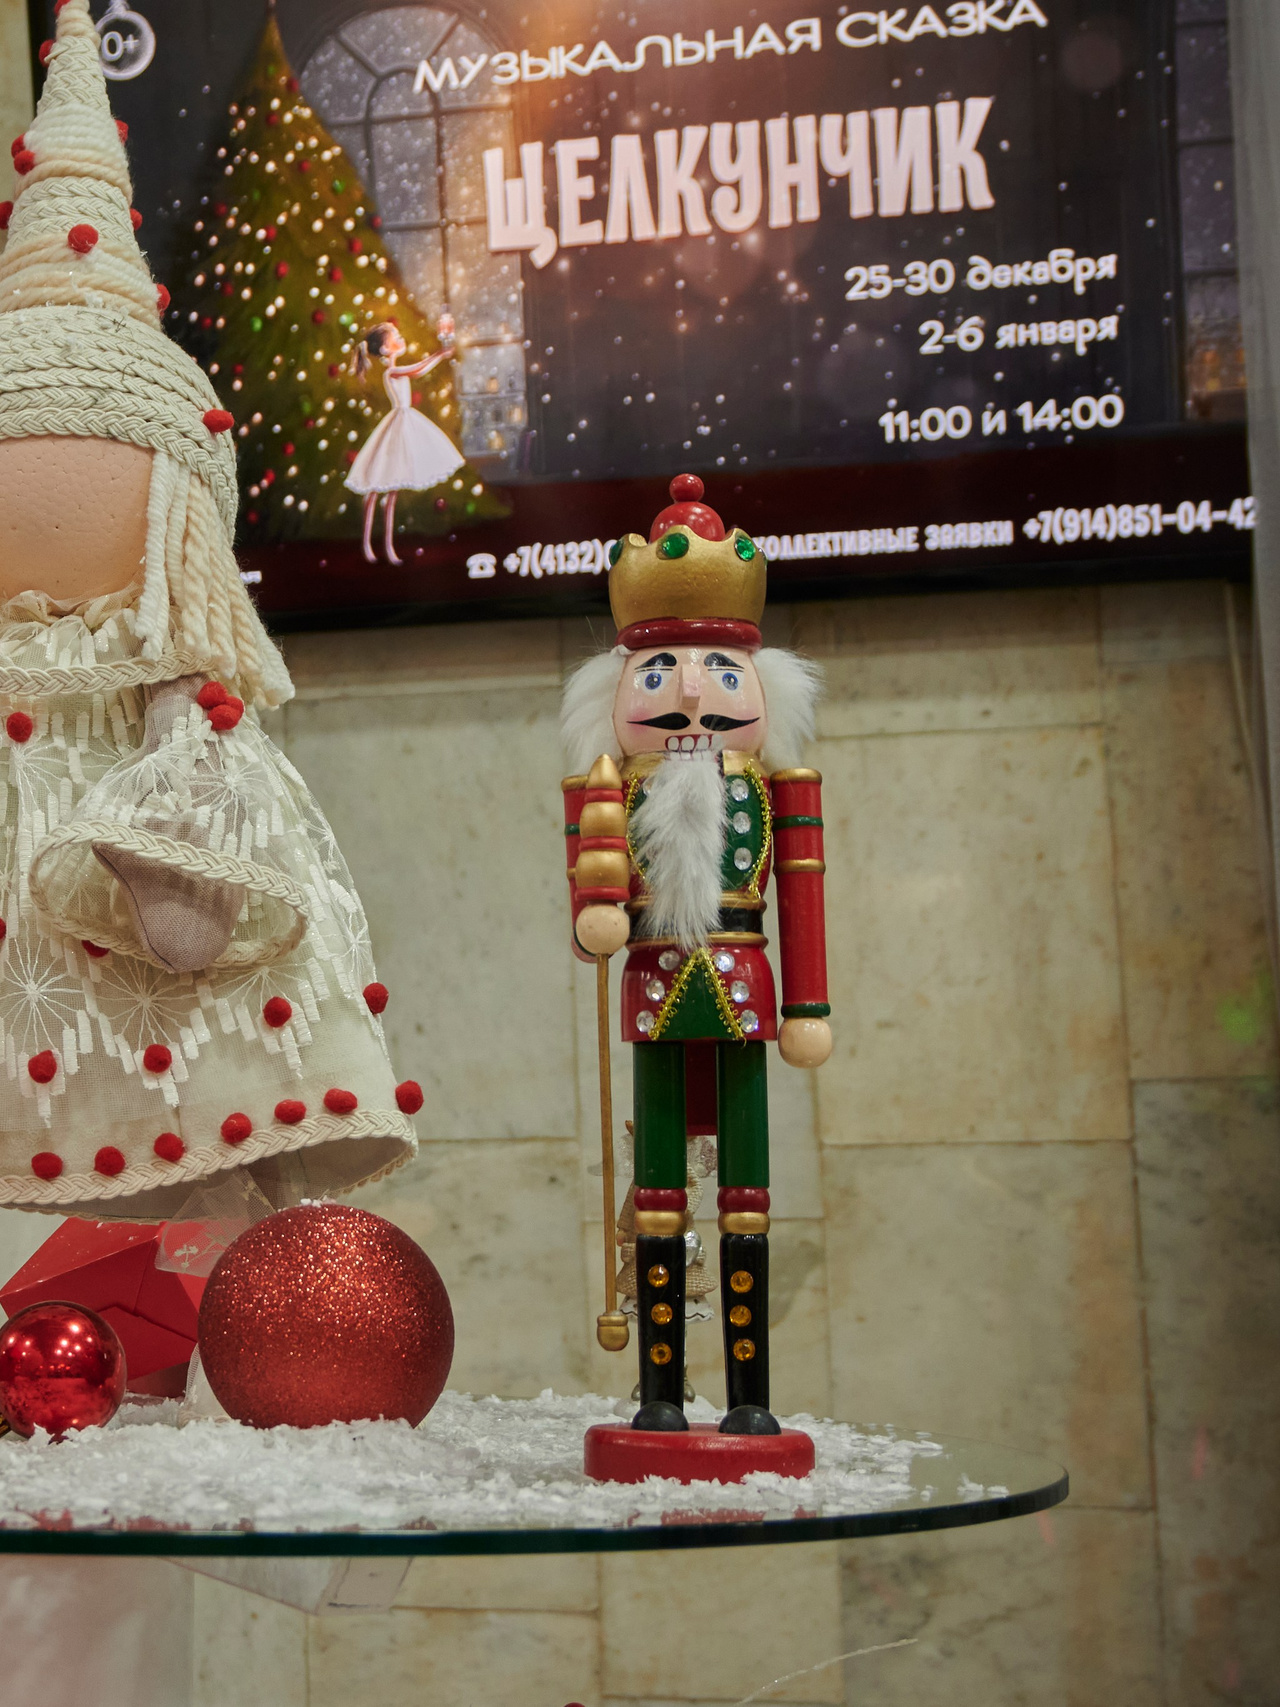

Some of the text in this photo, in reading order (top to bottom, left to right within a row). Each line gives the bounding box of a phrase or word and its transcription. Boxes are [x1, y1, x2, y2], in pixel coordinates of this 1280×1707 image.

[101, 30, 140, 62] 0+
[412, 0, 1048, 94] МУЗЫКАЛЬНАЯ СКАЗКА
[482, 95, 995, 269] ЩЕЛКУНЧИК
[844, 247, 1119, 300] 25-30 декабря
[918, 313, 1120, 356] 2-6 января
[878, 393, 1125, 443] 11:00 и 14:00
[924, 520, 1014, 551] ЗАЯВКИ
